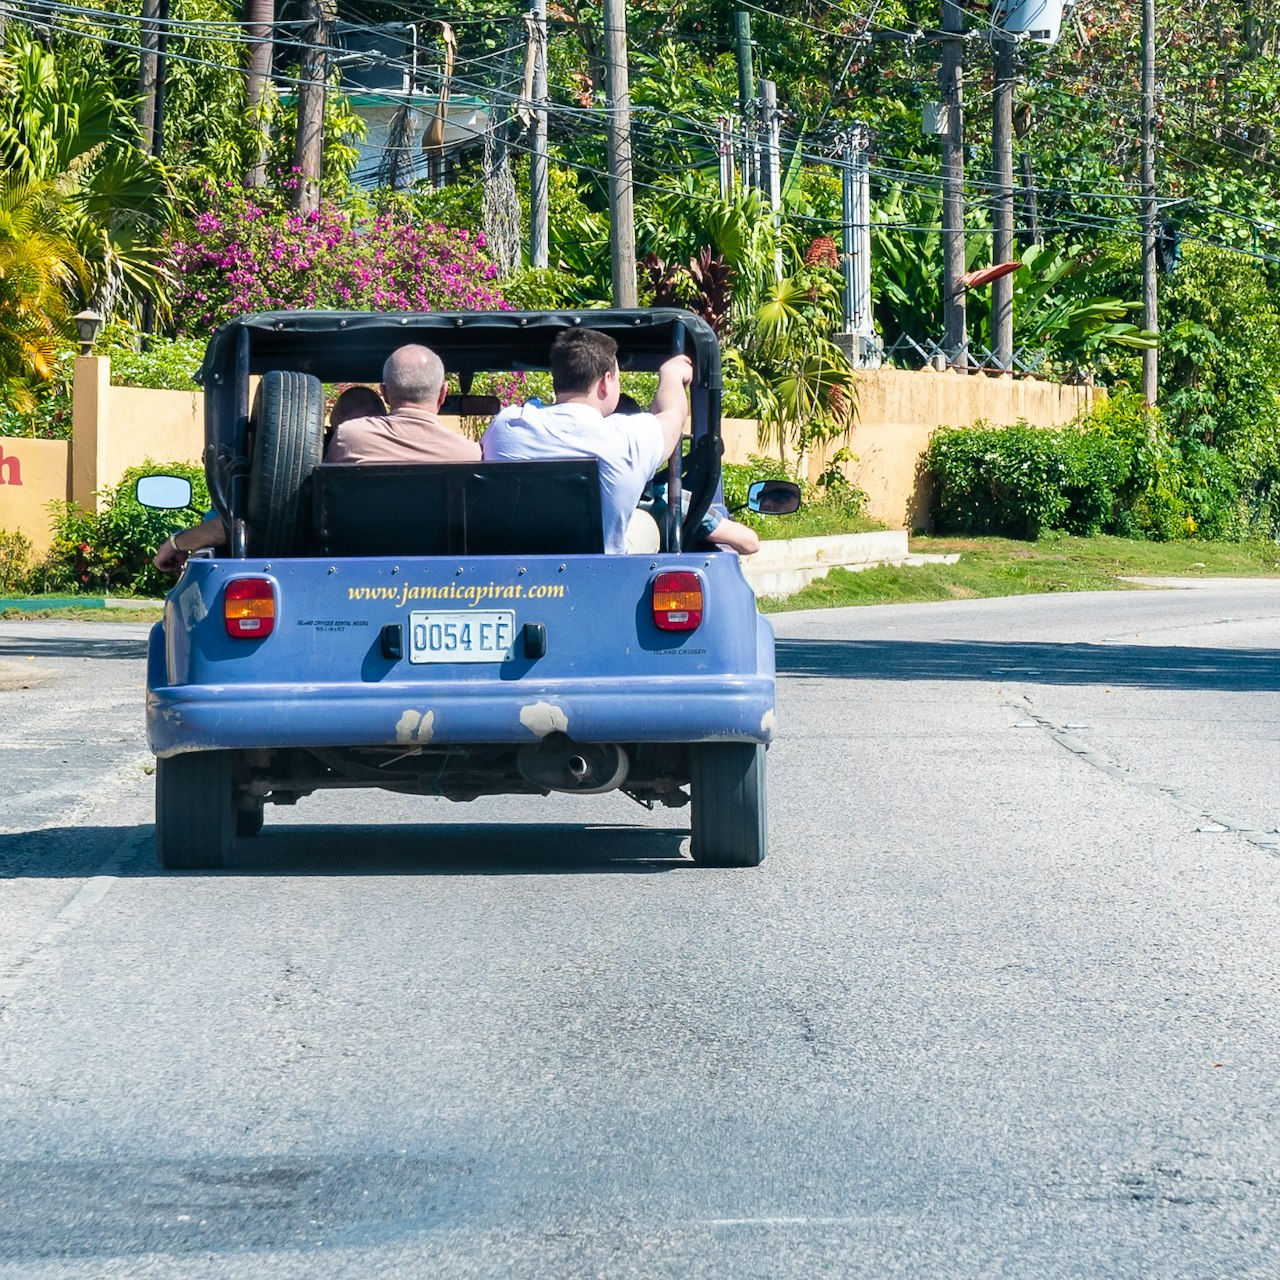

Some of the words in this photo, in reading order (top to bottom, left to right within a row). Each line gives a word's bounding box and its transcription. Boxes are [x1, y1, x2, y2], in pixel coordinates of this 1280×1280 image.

[348, 581, 565, 608] www.jamaicapirat.com
[413, 623, 473, 651] 0054
[479, 622, 510, 651] EE
[678, 648, 707, 656] CRUISER
